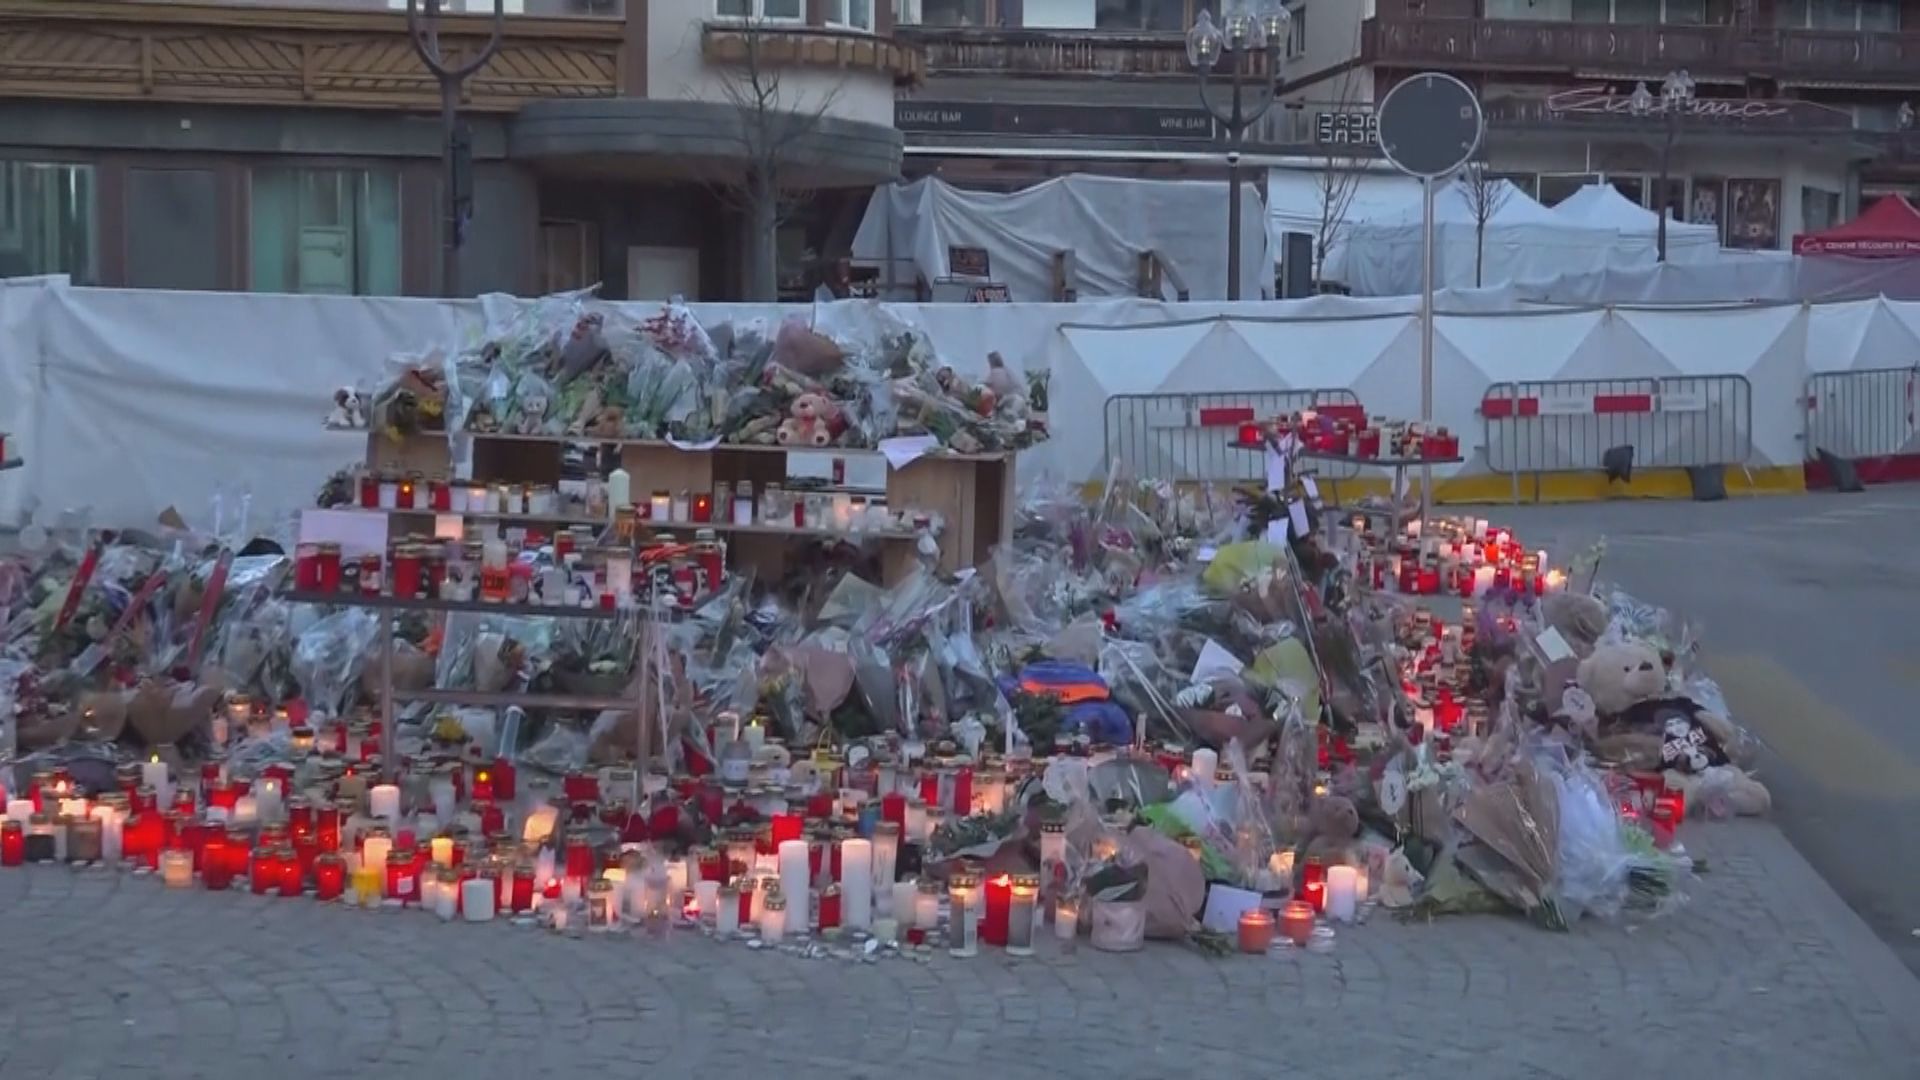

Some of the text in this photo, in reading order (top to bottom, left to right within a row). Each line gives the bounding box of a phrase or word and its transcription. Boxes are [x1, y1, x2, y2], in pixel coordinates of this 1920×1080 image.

[898, 111, 962, 124] LOUNGE BAR
[1159, 117, 1206, 130] WINE BAR
[1825, 240, 1856, 250] CENTRE
